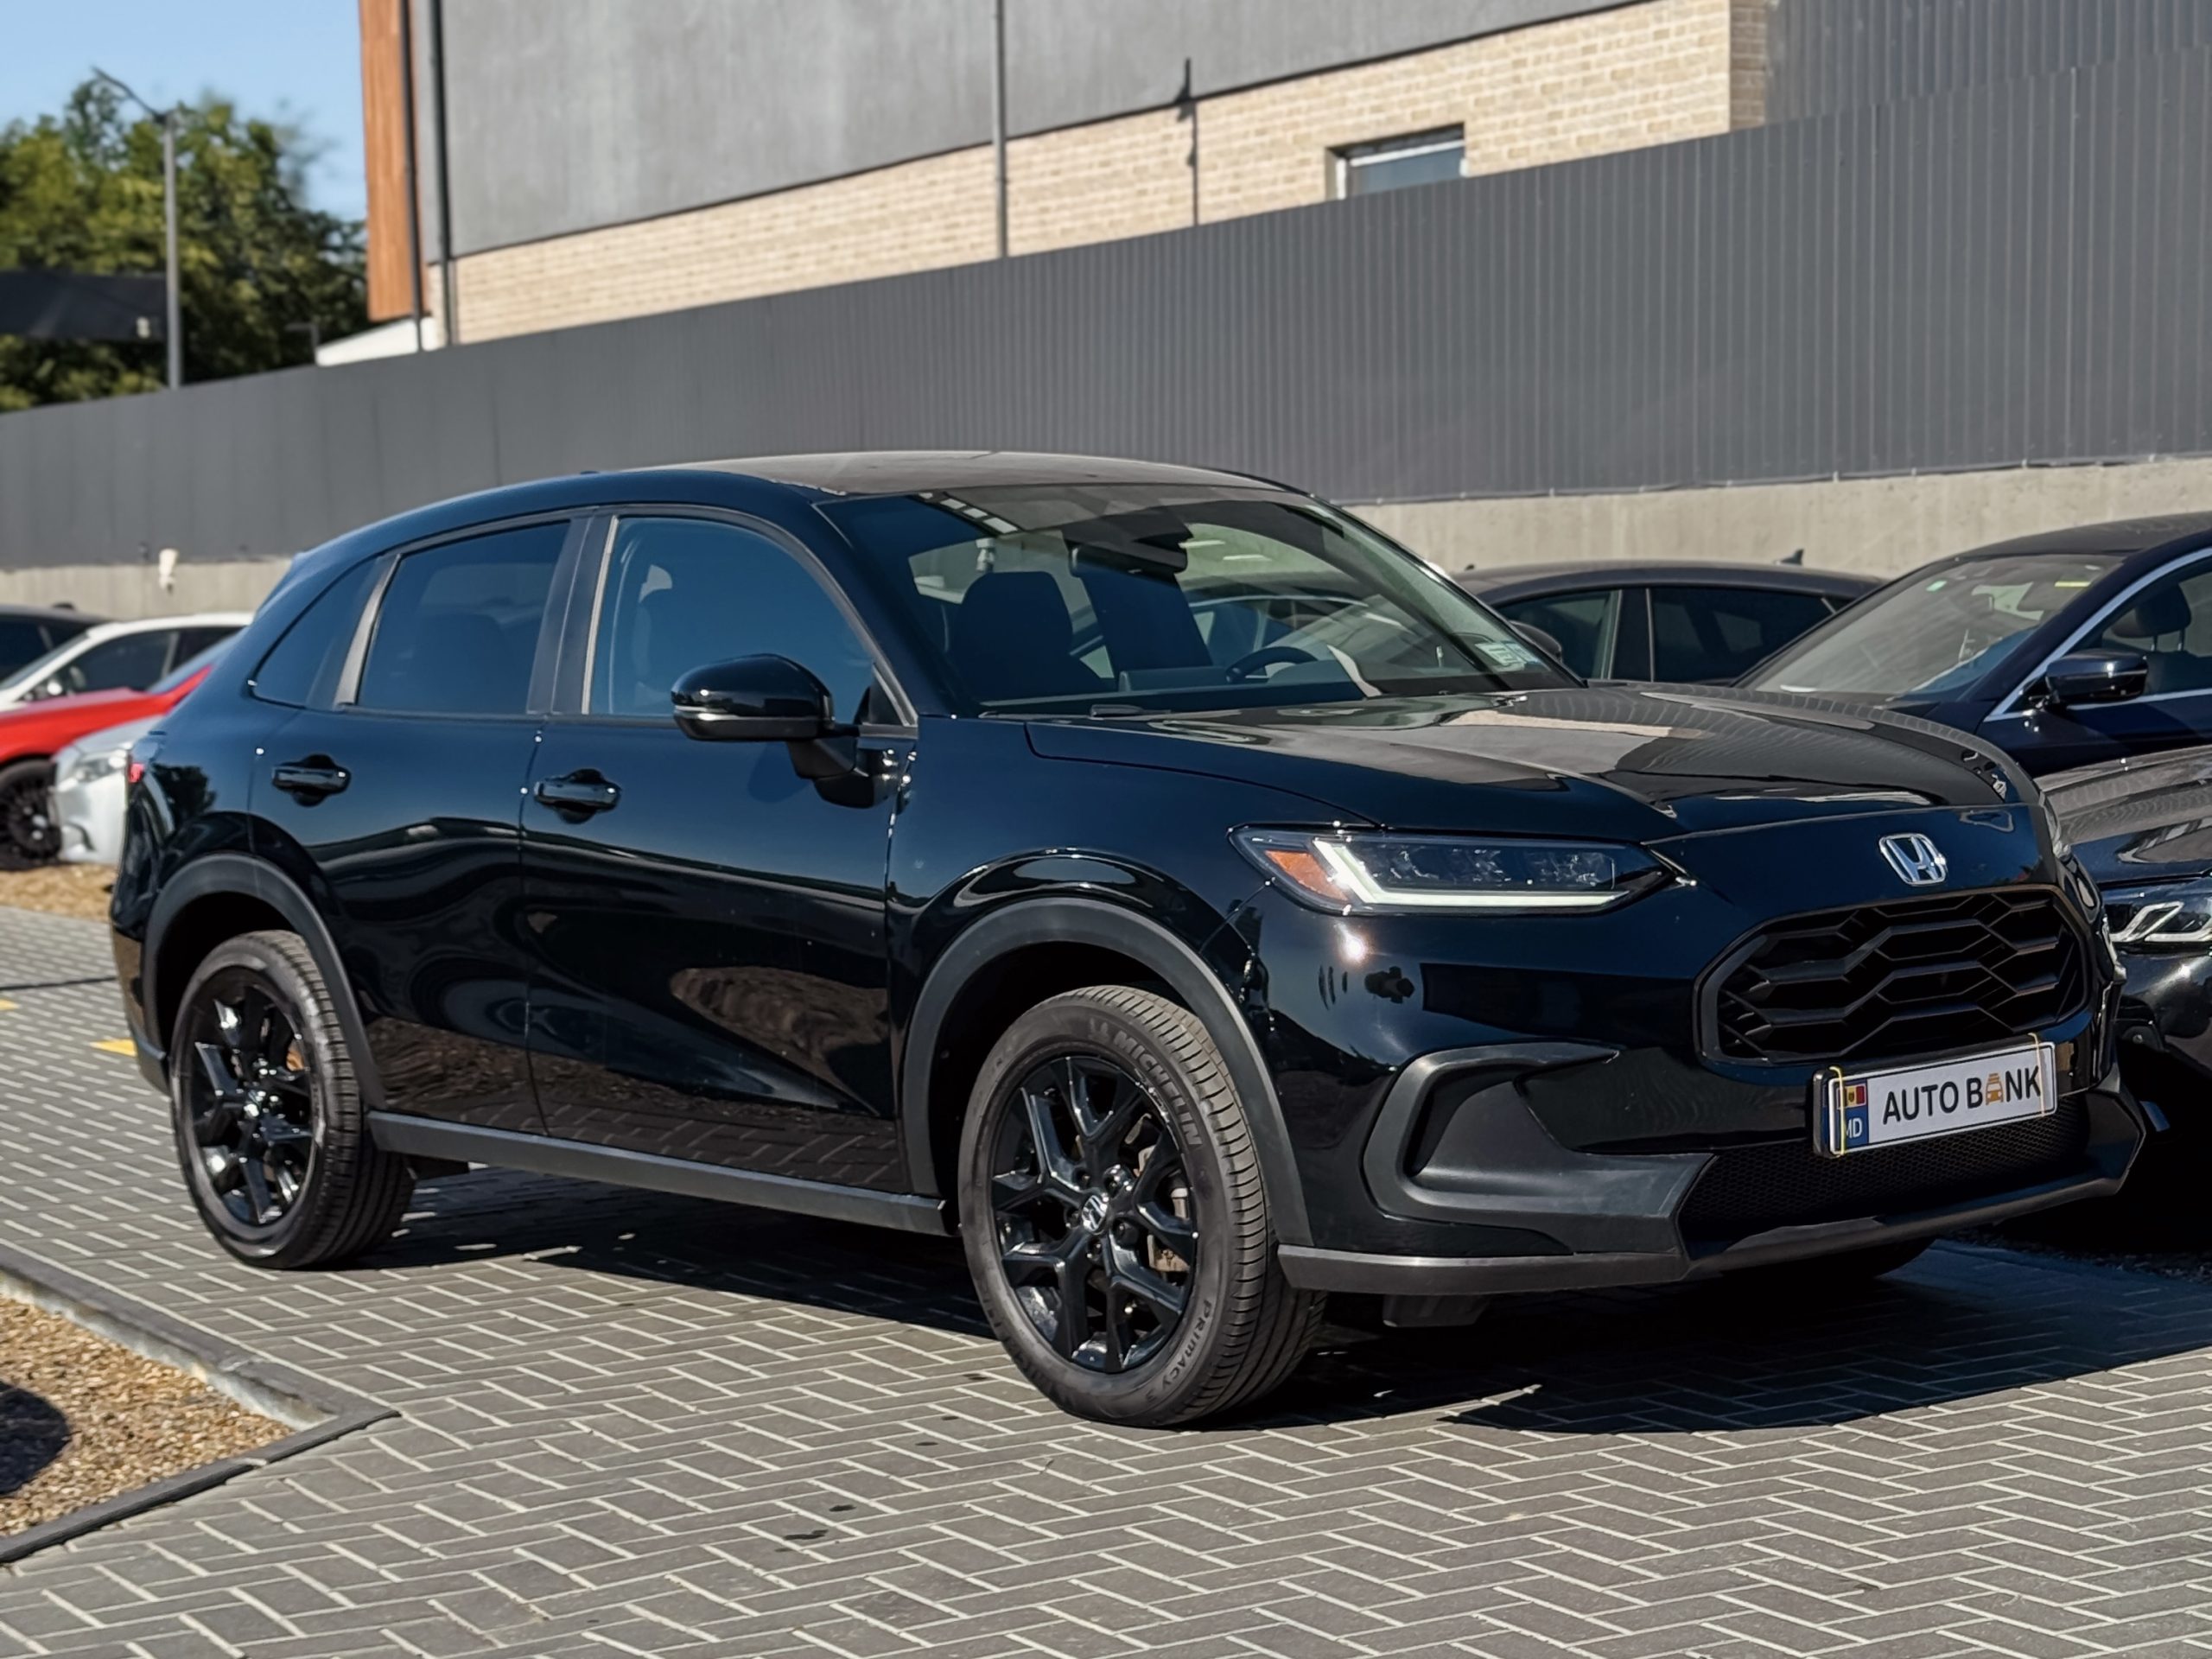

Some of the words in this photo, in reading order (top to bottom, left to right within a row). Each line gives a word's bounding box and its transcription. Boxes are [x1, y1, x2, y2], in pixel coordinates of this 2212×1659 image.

[1113, 1030, 1203, 1145] MICHELIN
[1883, 1081, 1959, 1125] AUTO
[1162, 1299, 1212, 1390] PRIMACY
